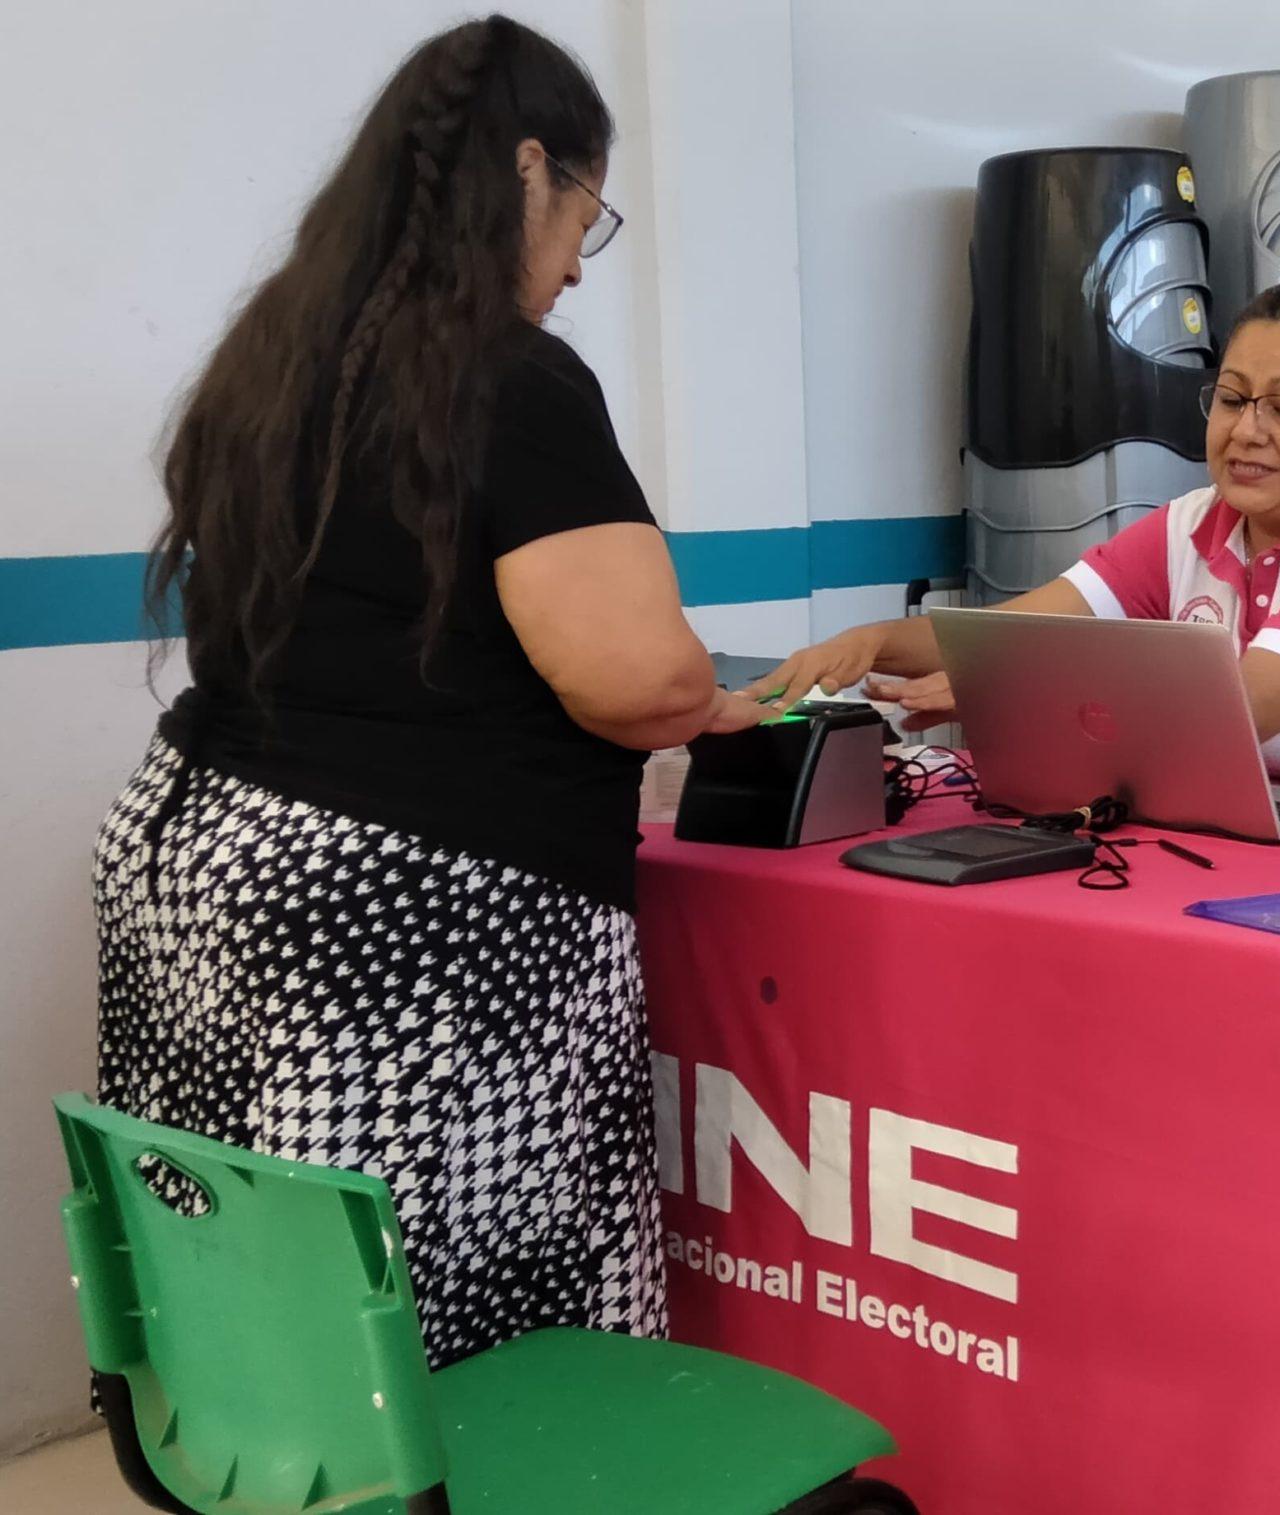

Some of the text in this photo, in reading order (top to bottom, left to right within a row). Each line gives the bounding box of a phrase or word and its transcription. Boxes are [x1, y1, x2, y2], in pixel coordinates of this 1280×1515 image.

[651, 1050, 1019, 1305] INE
[665, 1230, 1019, 1383] acional Electoral
